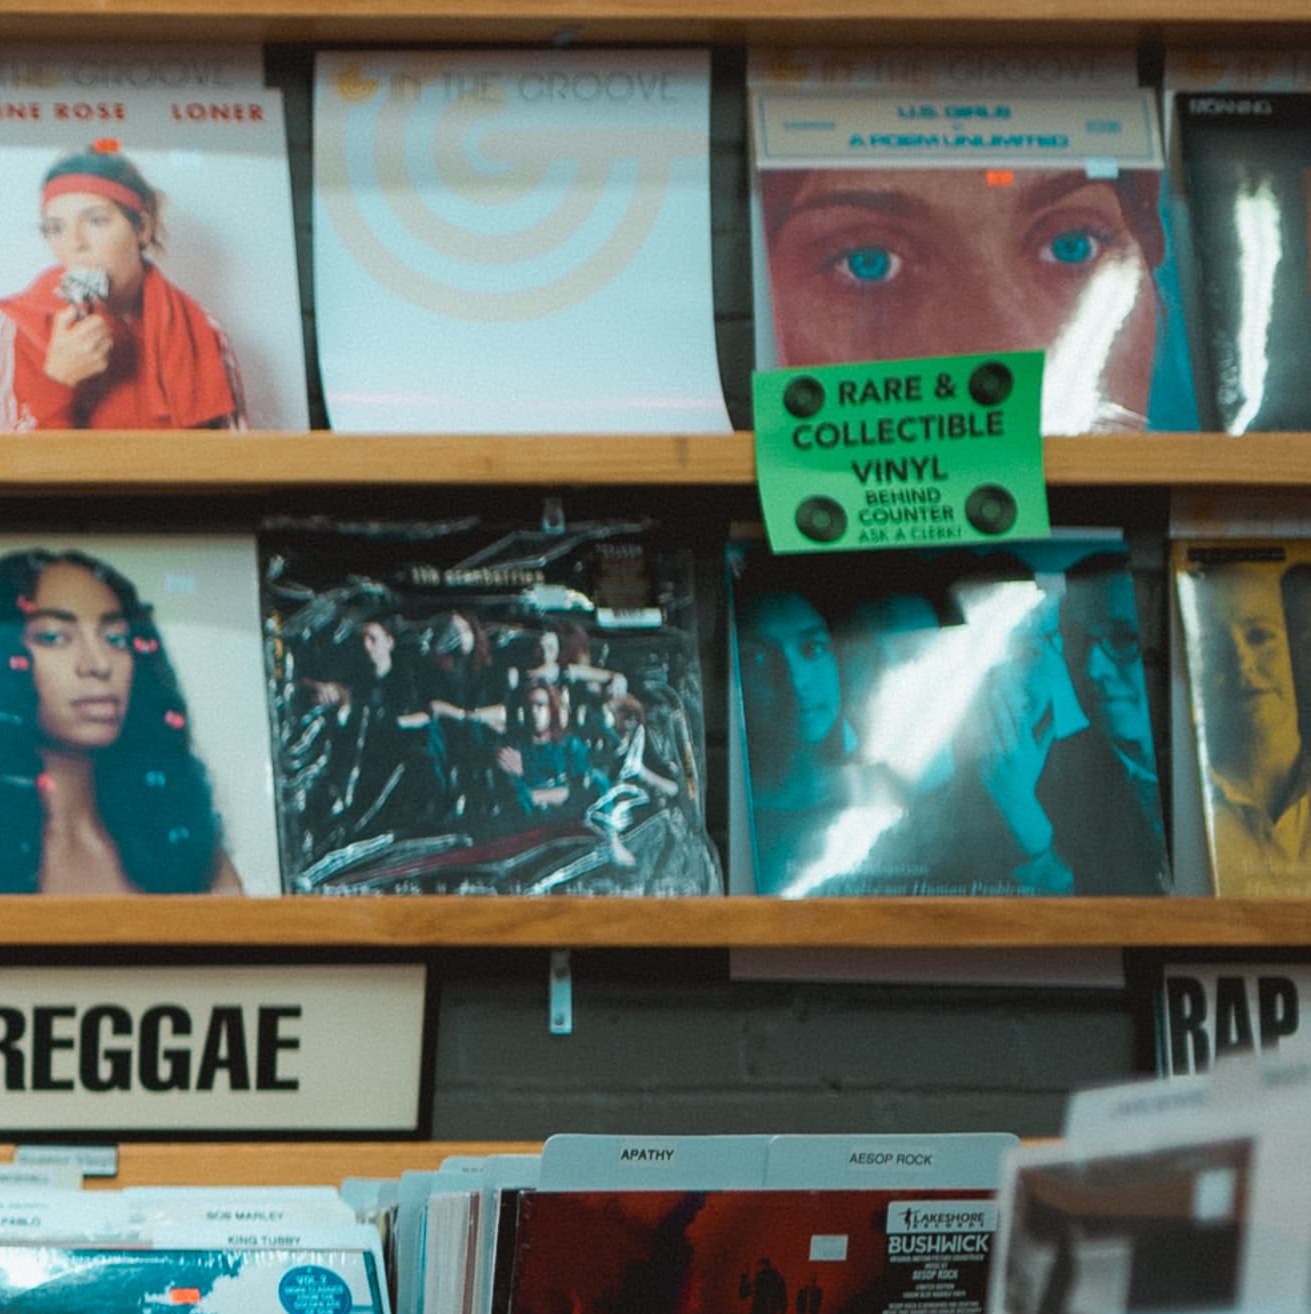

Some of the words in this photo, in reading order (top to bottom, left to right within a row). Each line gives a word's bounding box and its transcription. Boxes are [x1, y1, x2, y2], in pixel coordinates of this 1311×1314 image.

[517, 71, 679, 101] GROOVE
[53, 101, 127, 122] ROSE
[171, 102, 266, 122] LONER
[838, 376, 922, 404] RARE
[935, 373, 956, 398] &
[792, 410, 1004, 450] COLLECTIBLE
[851, 456, 949, 483] VINYL
[865, 486, 941, 506] BEHIND
[858, 506, 954, 526] COUNTER
[1166, 975, 1300, 1076] RAP
[620, 1149, 675, 1161] APATHY
[849, 1152, 893, 1165] AESOP
[896, 1153, 932, 1166] ROCK
[0, 1216, 42, 1228] PABLO
[235, 1210, 285, 1221] MARLEY
[914, 1211, 985, 1224] LAKESHORE
[228, 1234, 258, 1247] KING
[888, 1233, 990, 1254] BUSHWICK
[912, 1270, 937, 1280] AESOP
[937, 1269, 959, 1280] ROCK
